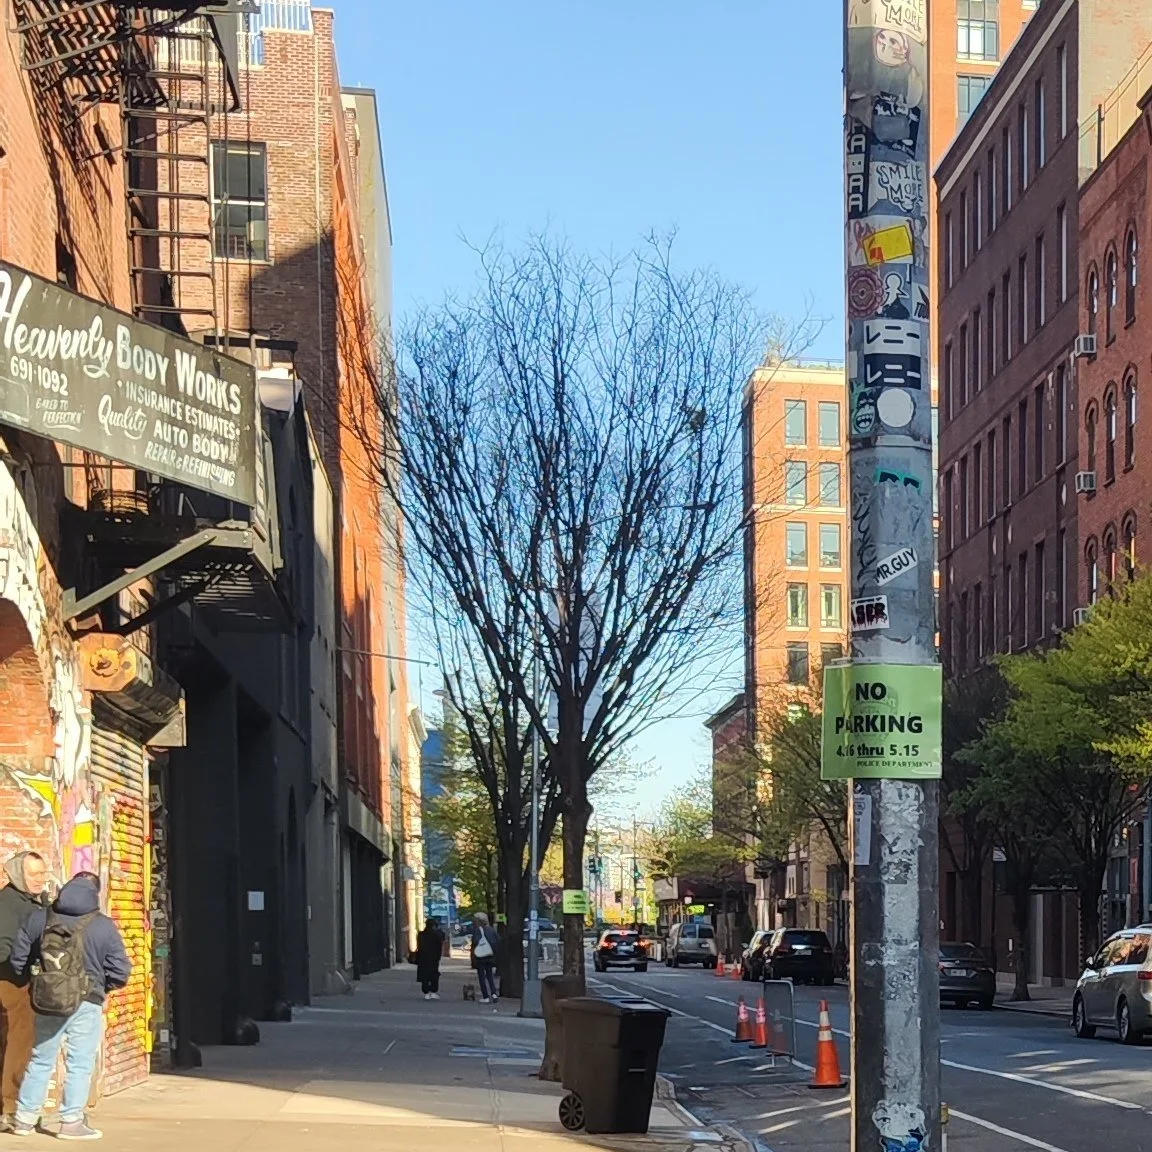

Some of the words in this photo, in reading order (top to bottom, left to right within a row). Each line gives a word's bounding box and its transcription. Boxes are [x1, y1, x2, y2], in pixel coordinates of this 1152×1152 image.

[877, 164, 921, 184] SMILE
[0, 270, 113, 378] Heavenly
[126, 381, 182, 420] INSURANCE
[185, 404, 236, 440] ESTIMATES
[98, 395, 147, 440] Quality
[154, 420, 188, 448] AUTO
[192, 434, 229, 462] BODY
[144, 441, 176, 466] REPAIR
[856, 683, 886, 700] NO
[836, 714, 922, 734] PARKING
[857, 744, 884, 757] thru
[889, 744, 919, 756] 5.15
